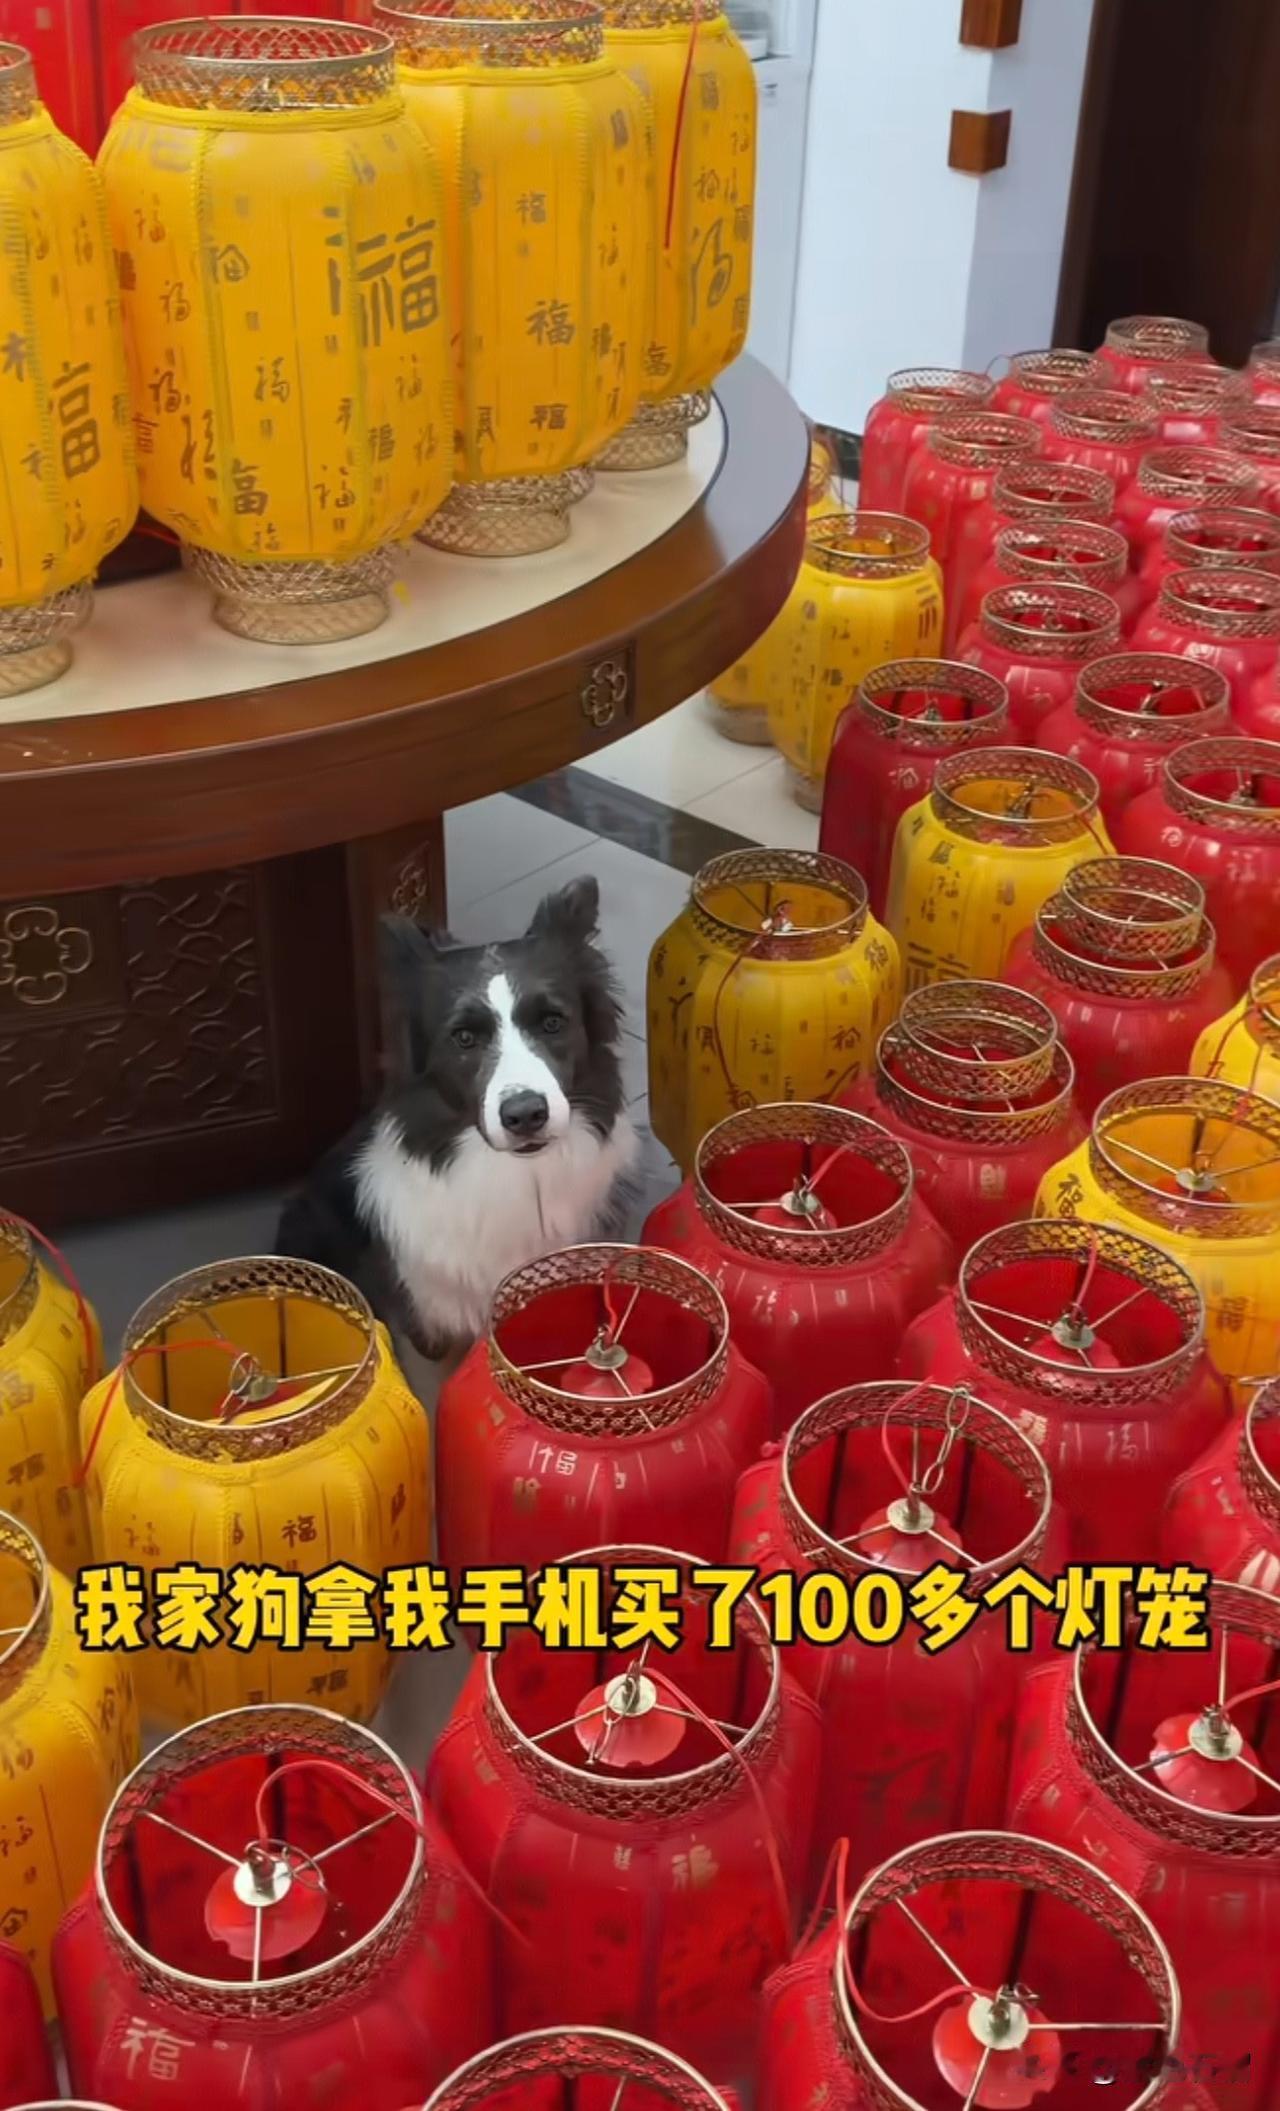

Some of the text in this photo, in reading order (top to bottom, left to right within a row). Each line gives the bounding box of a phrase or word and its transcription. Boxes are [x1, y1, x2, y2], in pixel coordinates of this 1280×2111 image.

[517, 190, 548, 226] 福
[356, 215, 440, 348] 福
[526, 299, 577, 347] 福
[529, 403, 569, 432] 福
[281, 1514, 318, 1549] 福
[120, 2015, 196, 2080] 福
